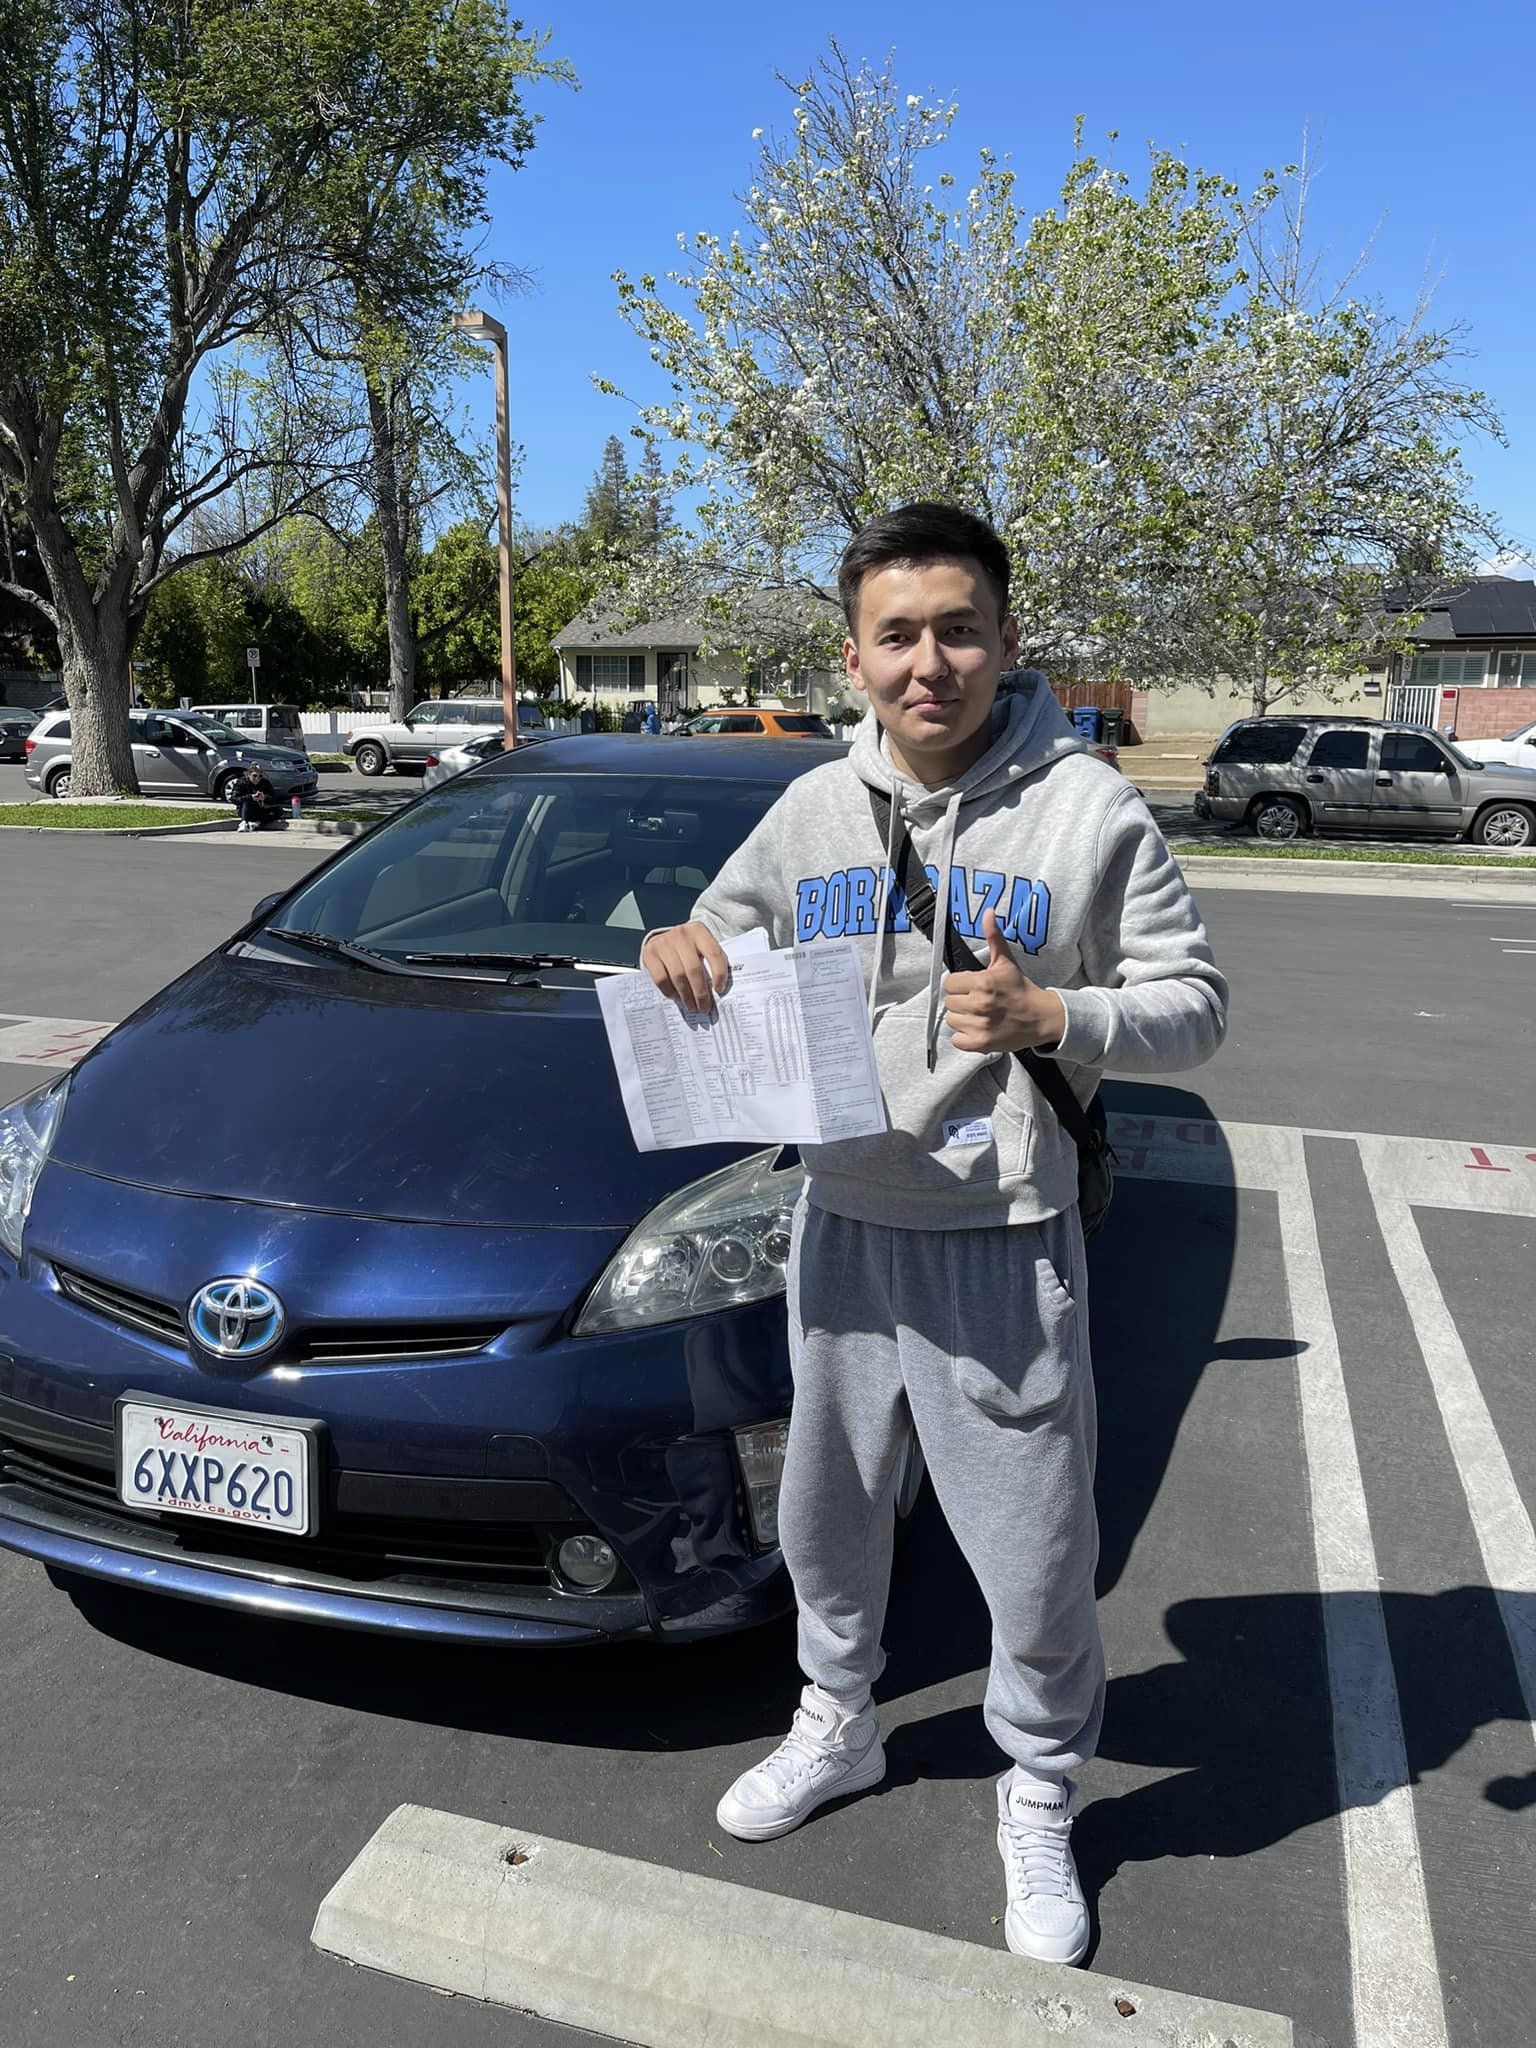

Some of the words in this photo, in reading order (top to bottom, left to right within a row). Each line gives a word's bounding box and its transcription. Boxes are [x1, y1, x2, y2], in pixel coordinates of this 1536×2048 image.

[160, 1417, 272, 1455] California
[134, 1448, 293, 1517] 6XXP620
[168, 1498, 262, 1520] dmv.ca.gov
[1015, 1795, 1064, 1811] JUMPMAN
